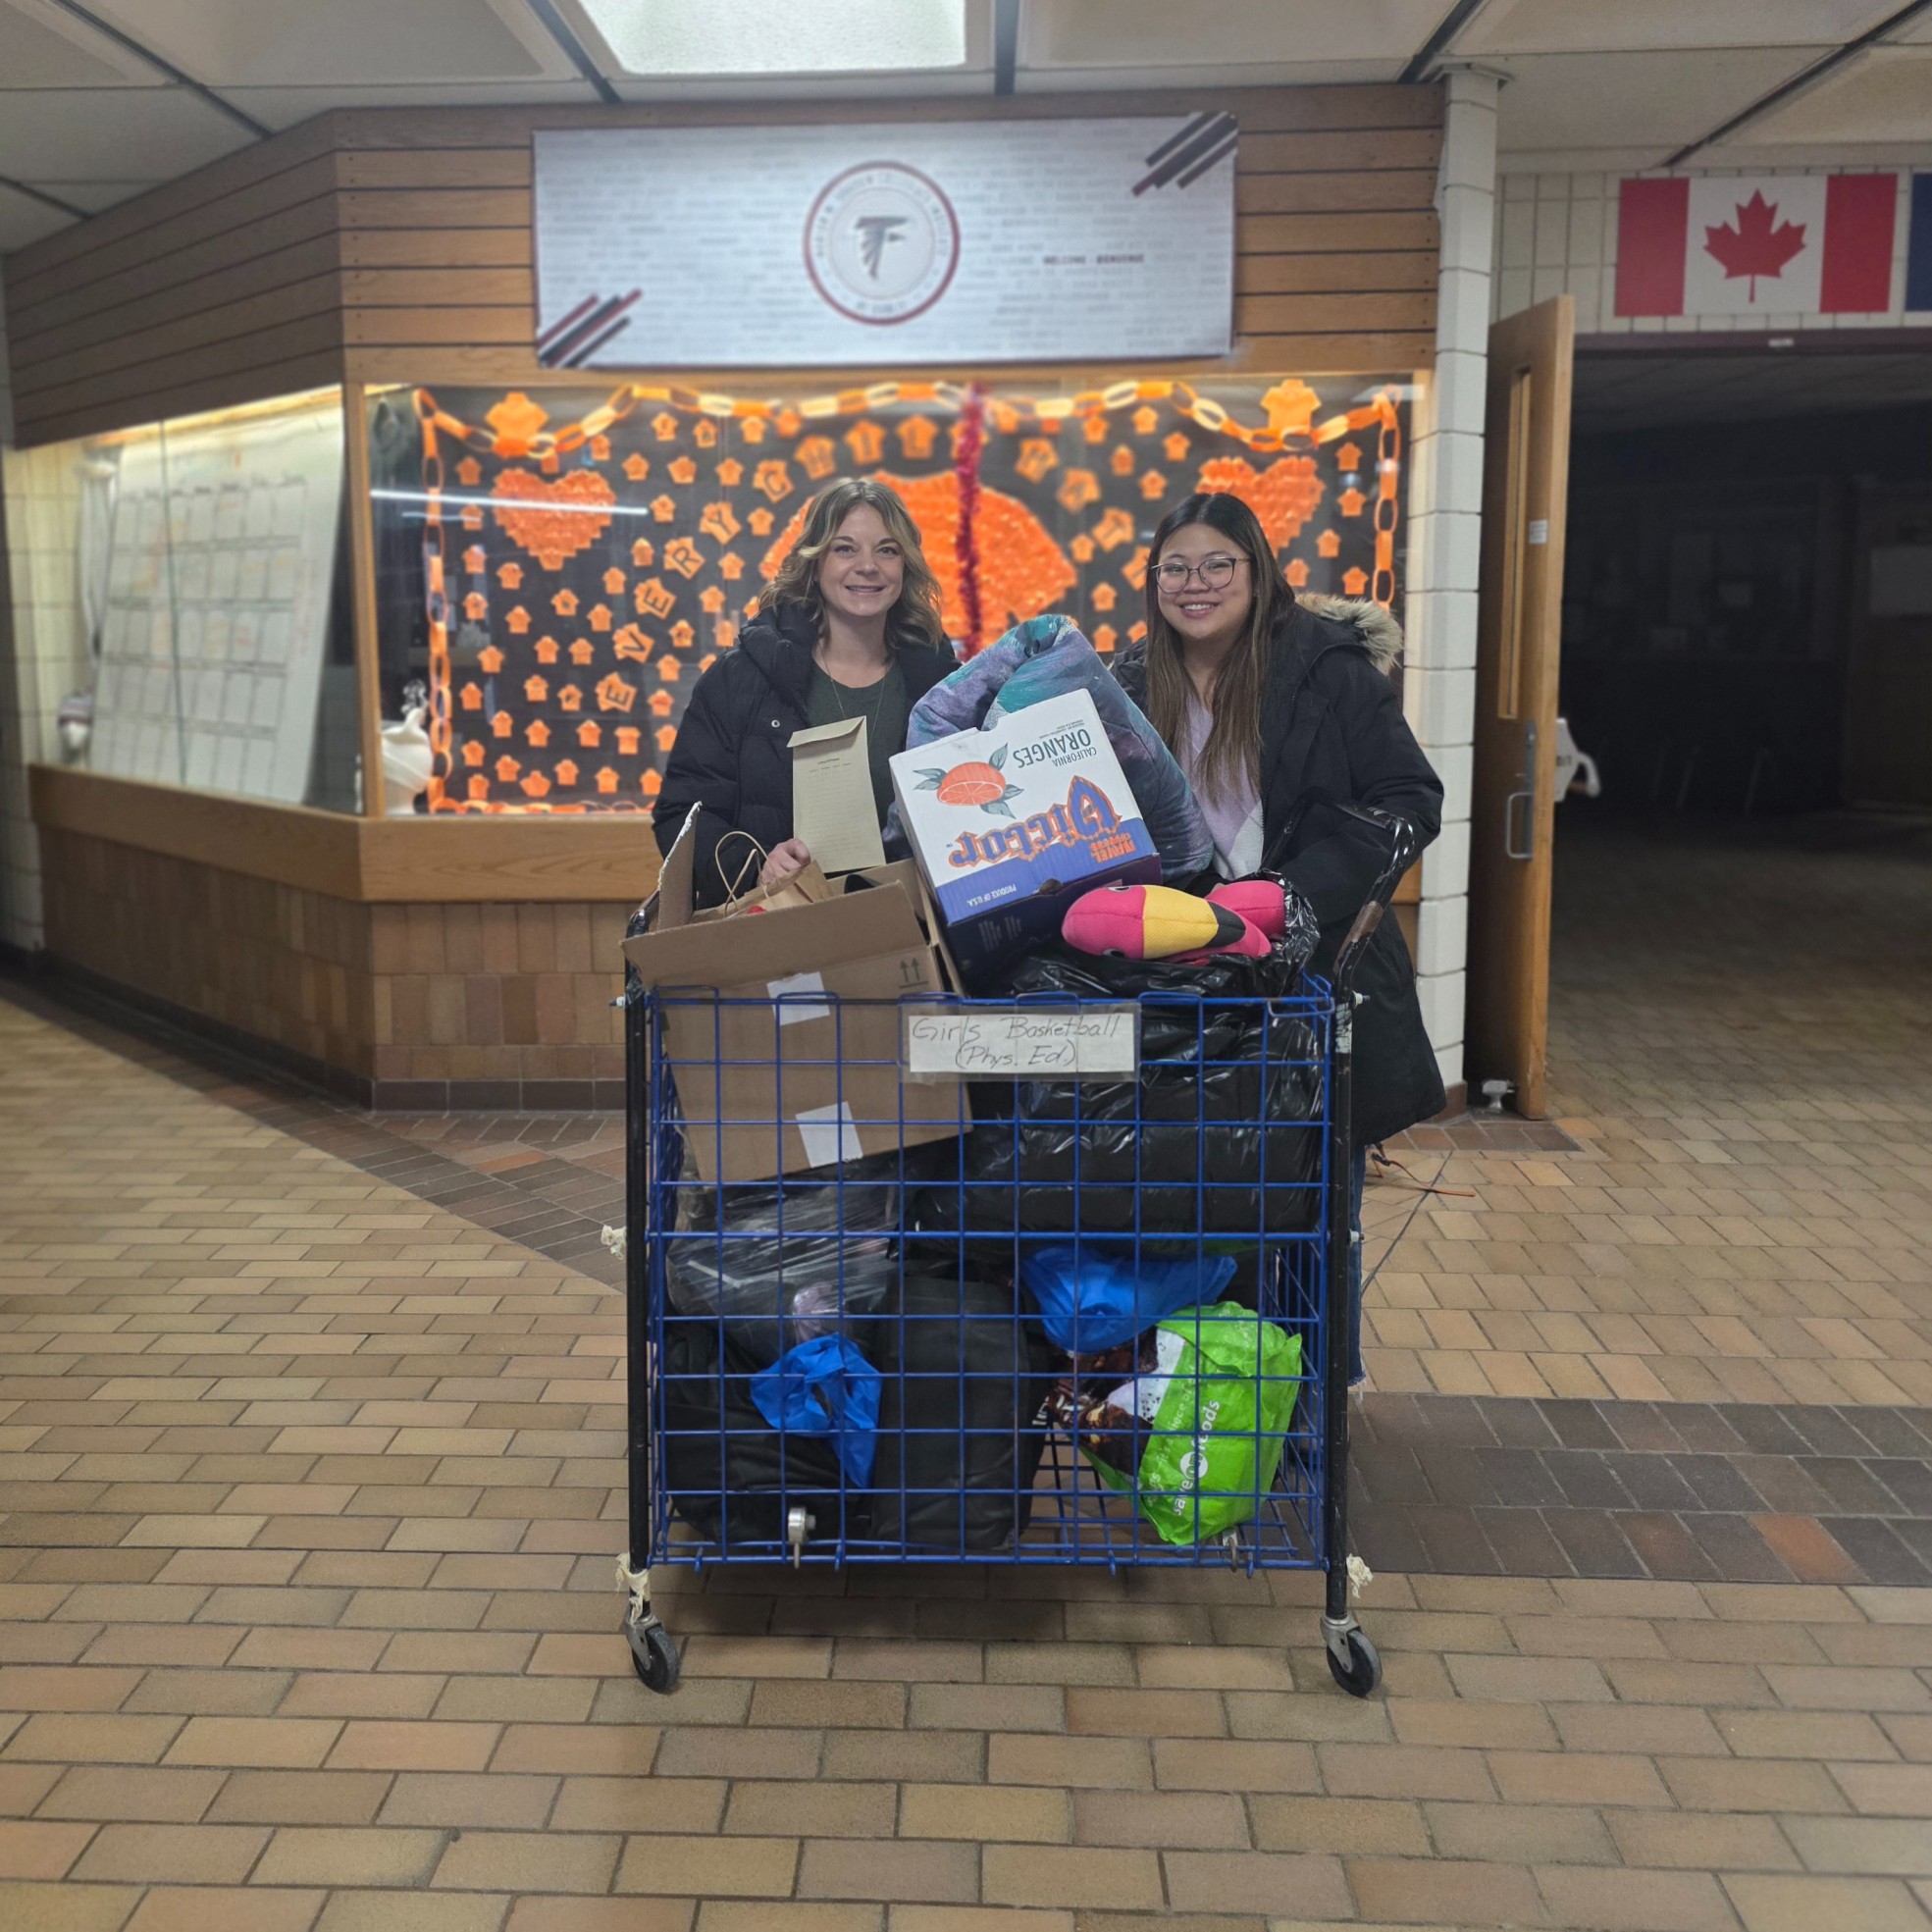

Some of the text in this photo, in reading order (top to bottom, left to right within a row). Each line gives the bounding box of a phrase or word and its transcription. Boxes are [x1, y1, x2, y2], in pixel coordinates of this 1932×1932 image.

[1013, 729, 1091, 768] ORANGES
[1052, 747, 1097, 767] CALIFORNIA
[948, 775, 1123, 868] Victor
[1091, 840, 1135, 863] NAVEL
[990, 884, 1017, 900] PRODUCE
[912, 1016, 1121, 1042] Girls Basketball
